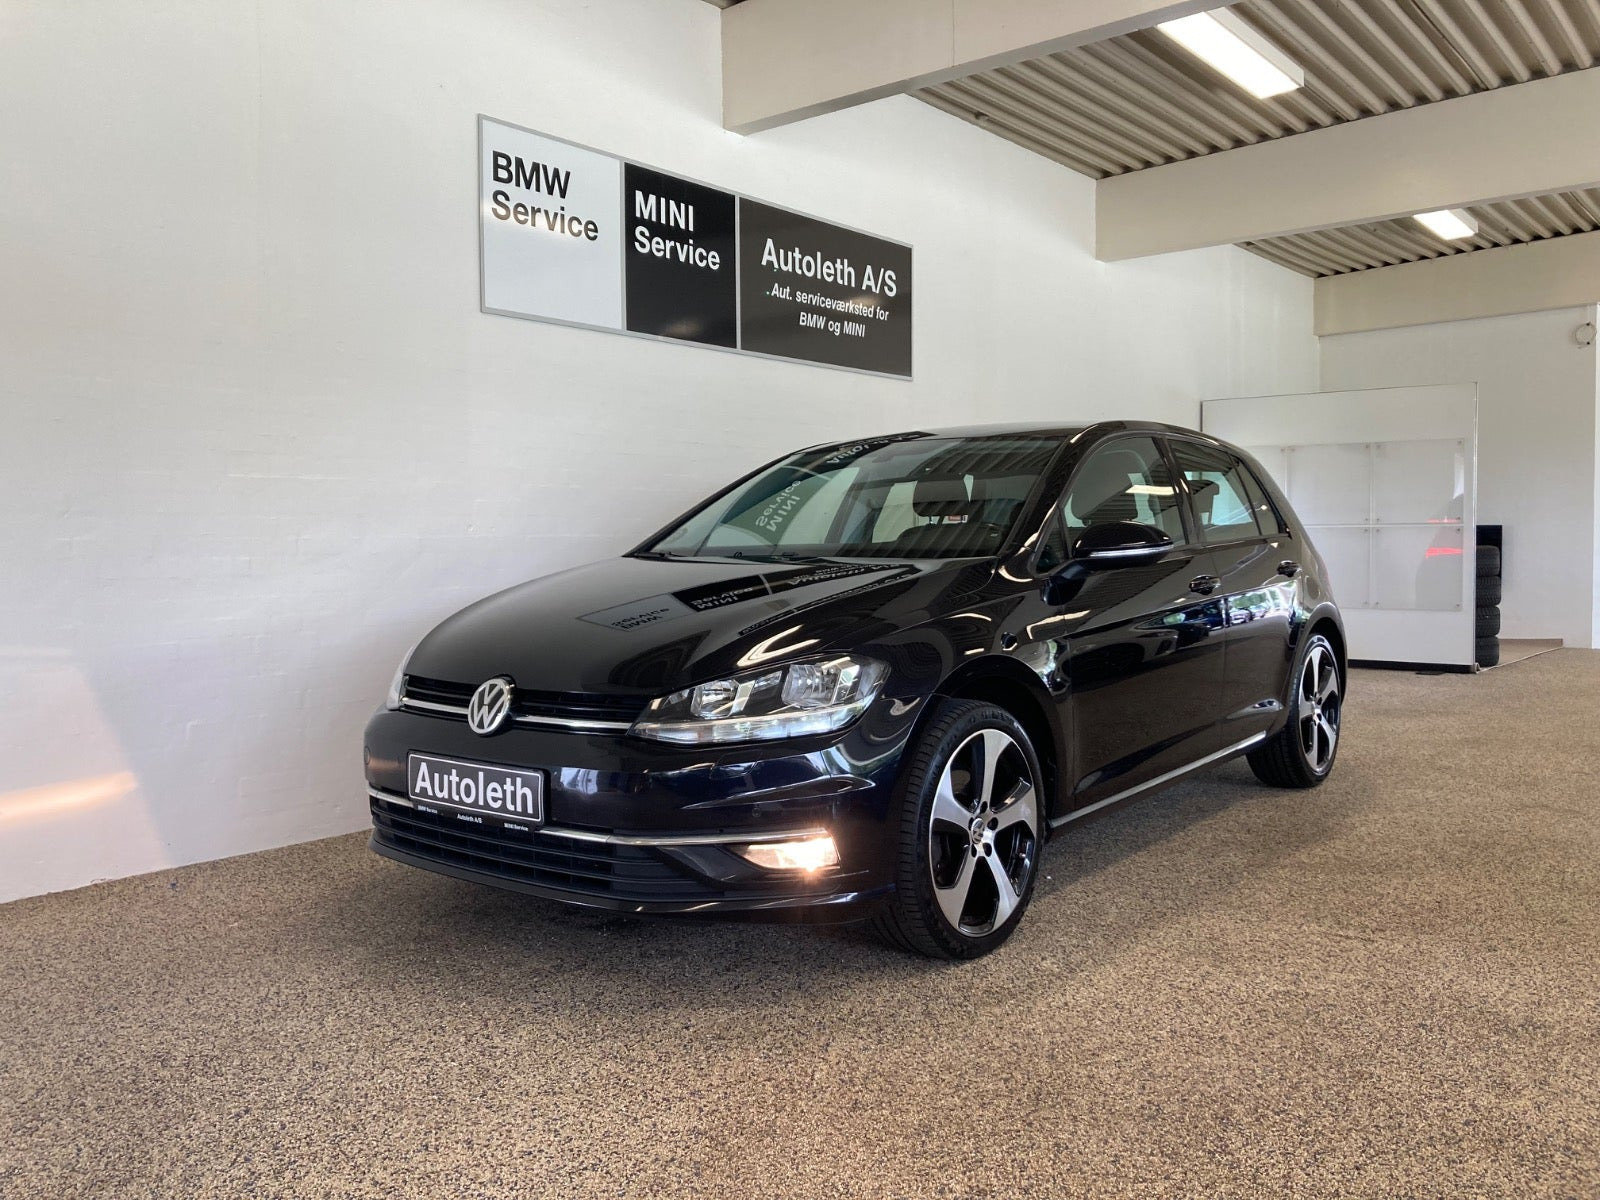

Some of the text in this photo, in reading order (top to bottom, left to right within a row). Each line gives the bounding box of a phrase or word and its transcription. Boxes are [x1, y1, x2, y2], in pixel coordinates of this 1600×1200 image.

[492, 150, 571, 199] BMW
[491, 190, 599, 241] Service
[635, 190, 694, 232] MINI
[634, 225, 721, 270] Service
[761, 237, 897, 297] Autoleth A/S
[771, 283, 889, 321] Aut. serviceværksted for
[799, 311, 866, 338] BMW og MINI
[415, 761, 533, 815] Autoleth
